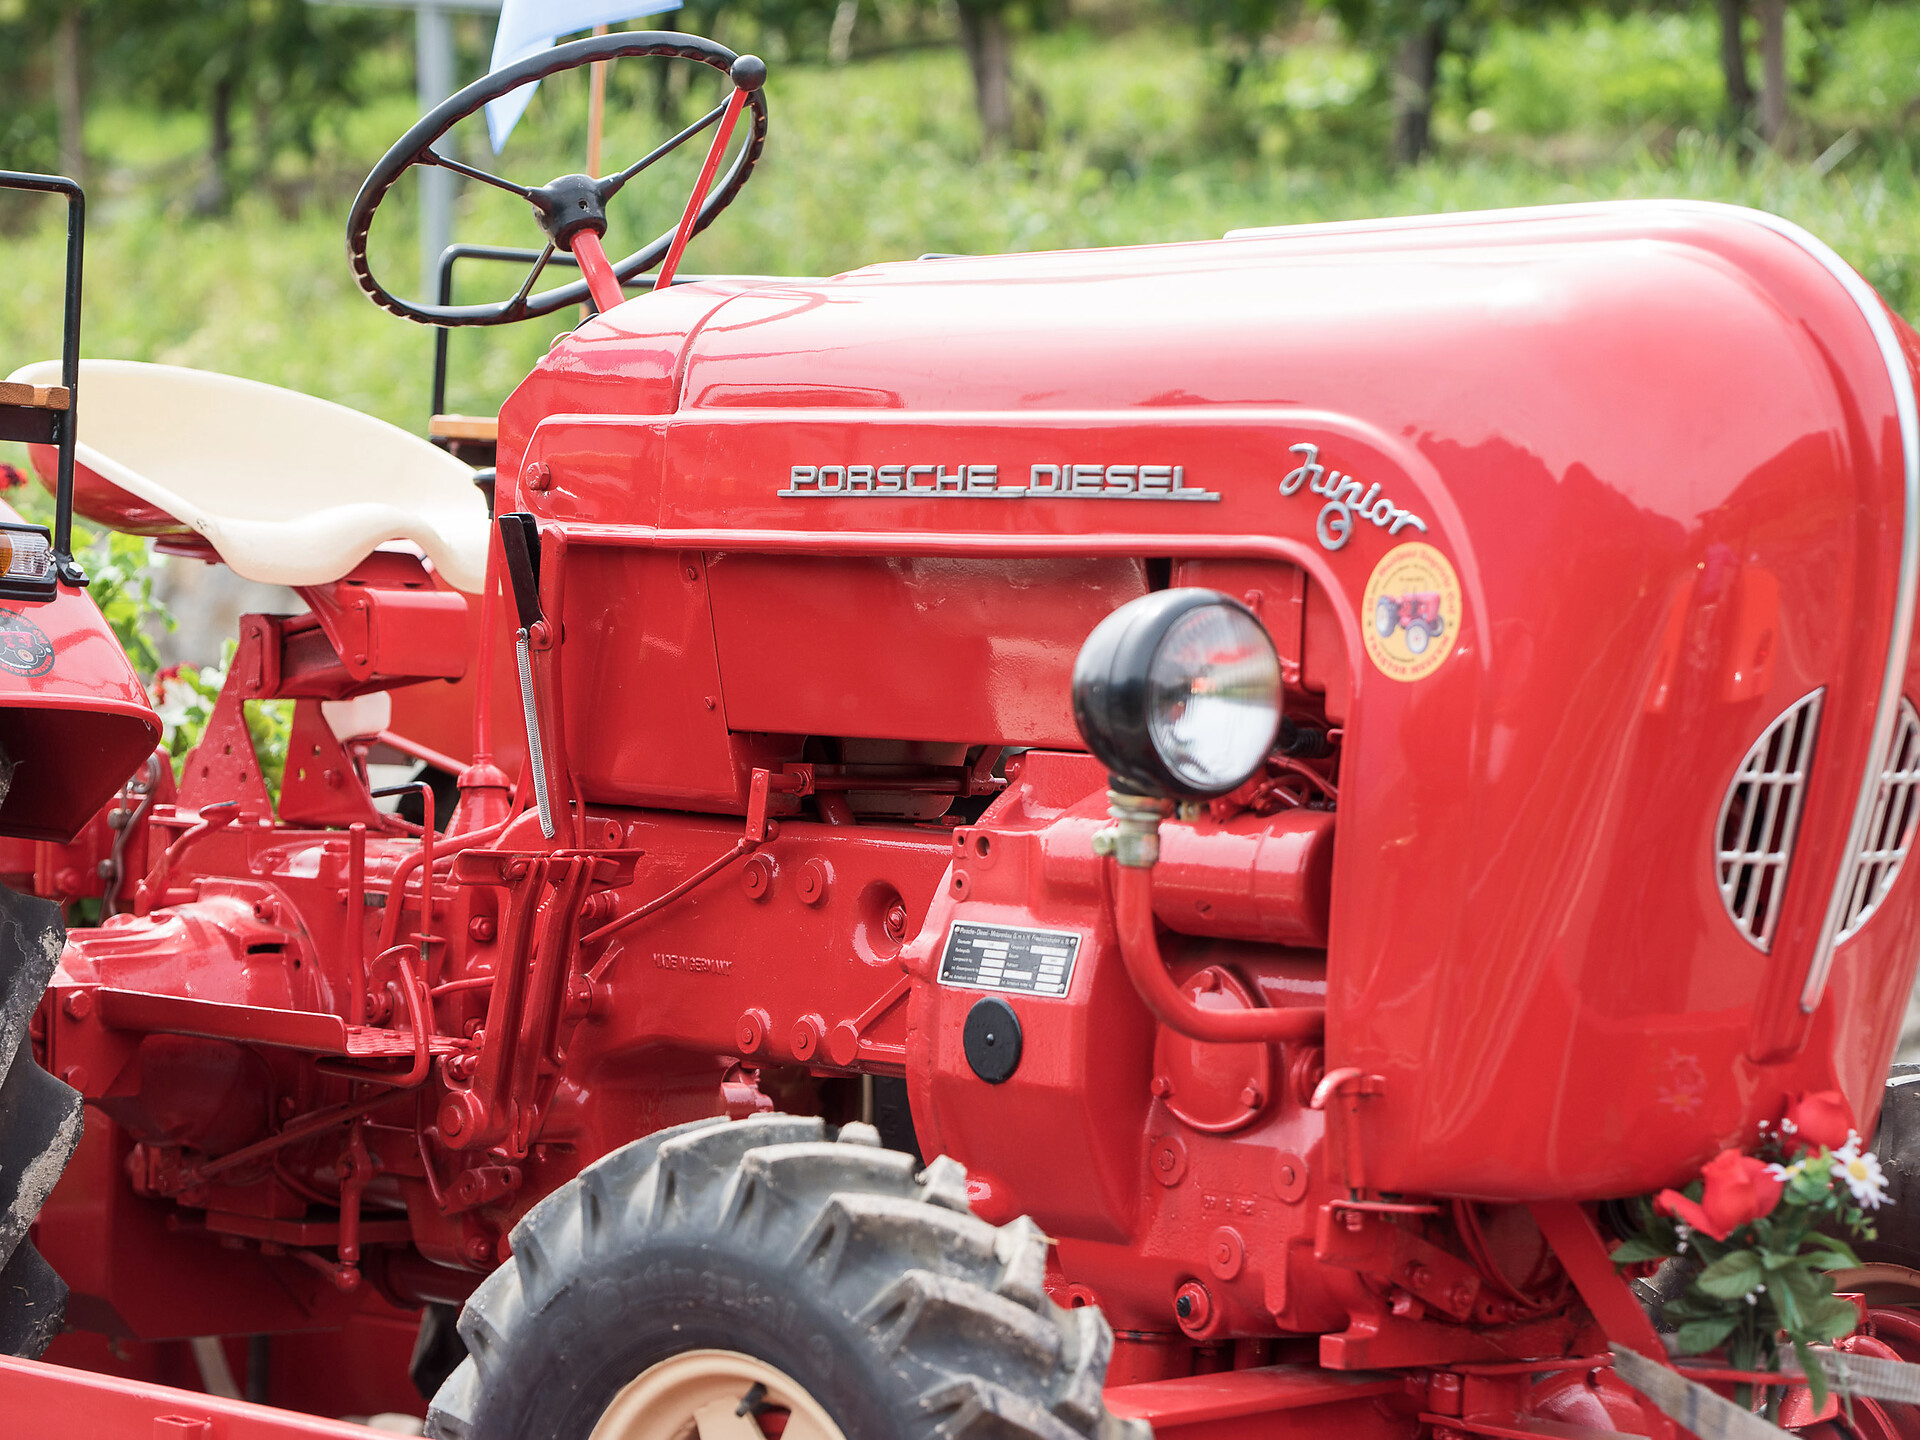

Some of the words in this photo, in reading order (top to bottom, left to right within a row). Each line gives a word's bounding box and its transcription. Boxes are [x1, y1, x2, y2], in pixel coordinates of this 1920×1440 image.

[790, 464, 999, 493] PORSCHE
[1029, 463, 1207, 494] DIESEL
[1279, 442, 1427, 551] Junior
